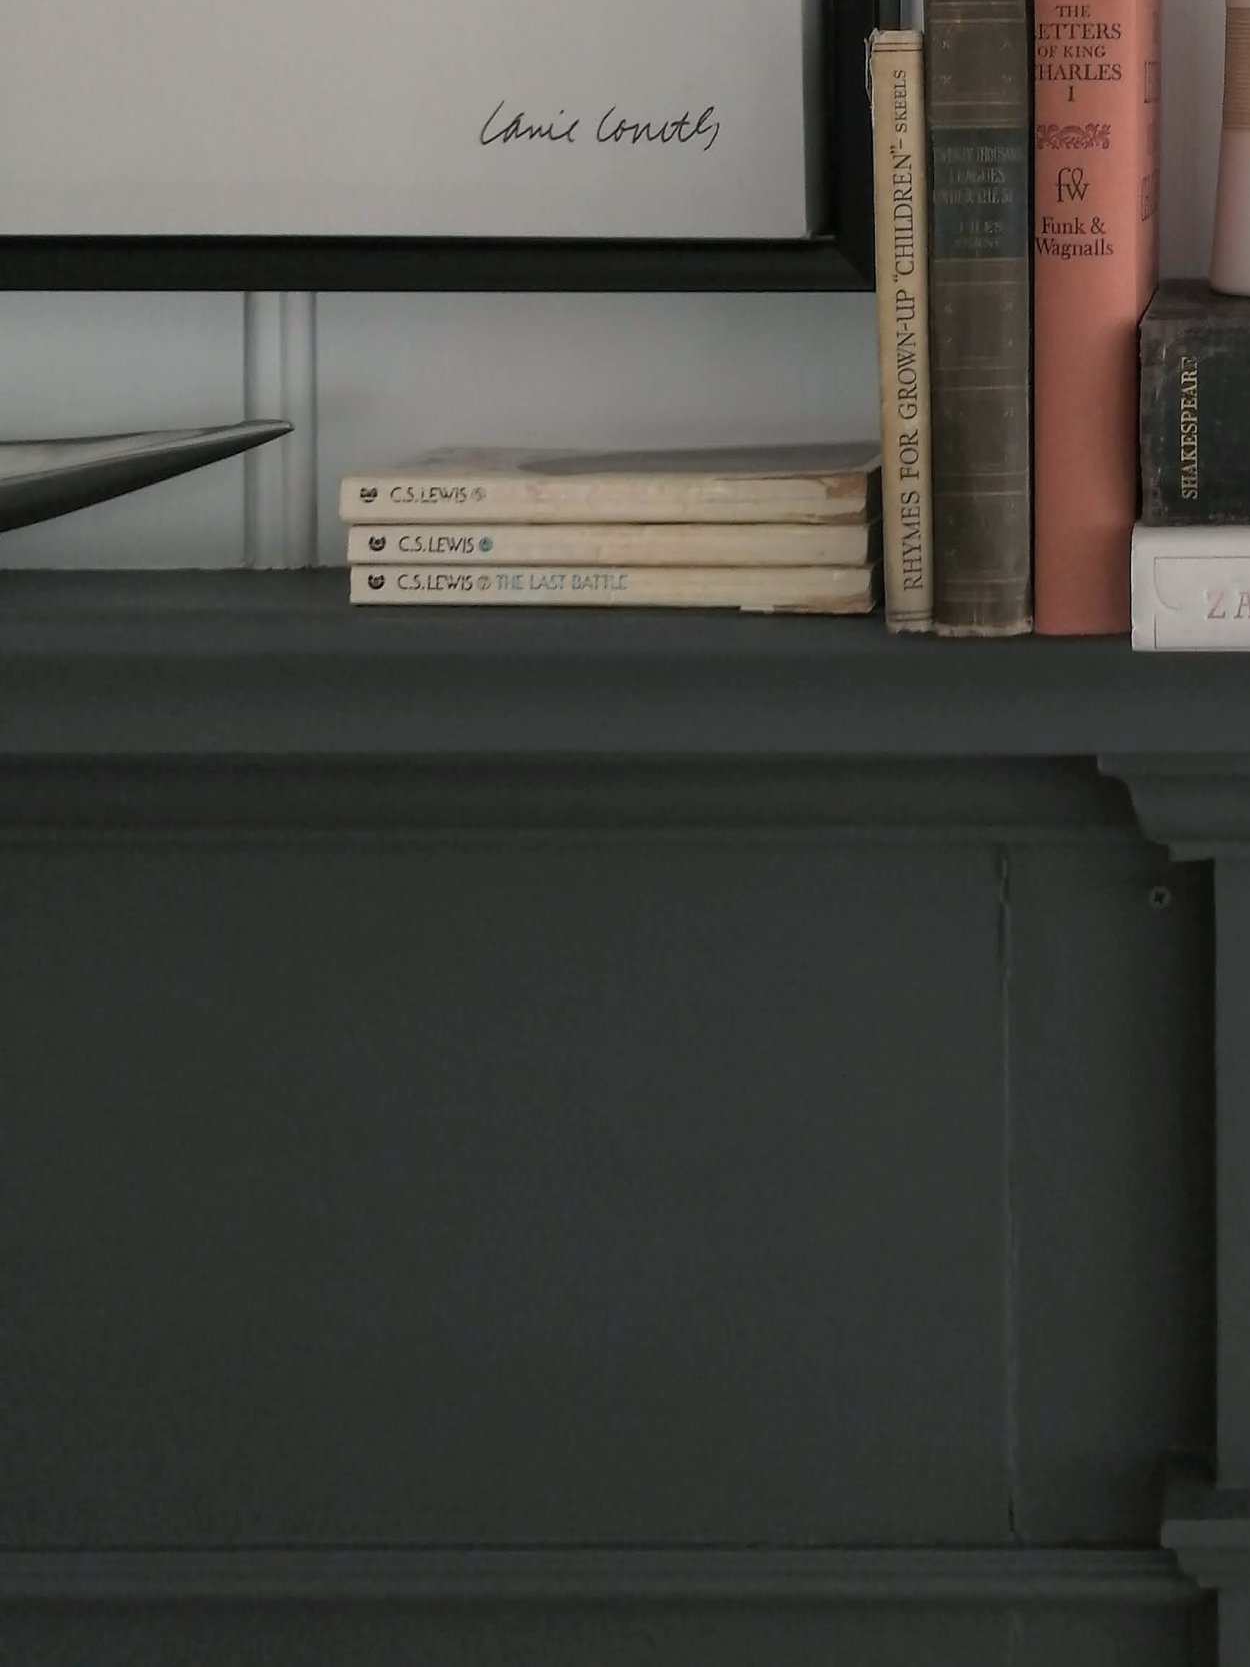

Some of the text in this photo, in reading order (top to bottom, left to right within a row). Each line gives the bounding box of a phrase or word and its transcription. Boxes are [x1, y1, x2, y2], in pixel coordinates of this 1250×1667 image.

[1056, 5, 1091, 18] THE
[1036, 23, 1122, 40] ETTERS
[1037, 45, 1106, 58] OF KING
[1035, 63, 1122, 81] HARLES
[893, 69, 908, 132] SKEELS
[1041, 215, 1106, 235] Funk &
[1035, 237, 1114, 261] Wagnalls
[895, 289, 919, 420] GROWN-UP
[898, 429, 919, 480] FOR
[900, 490, 923, 592] RHYMES
[495, 574, 524, 591] THE
[529, 574, 566, 591] LAST
[571, 574, 628, 591] BATTLE
